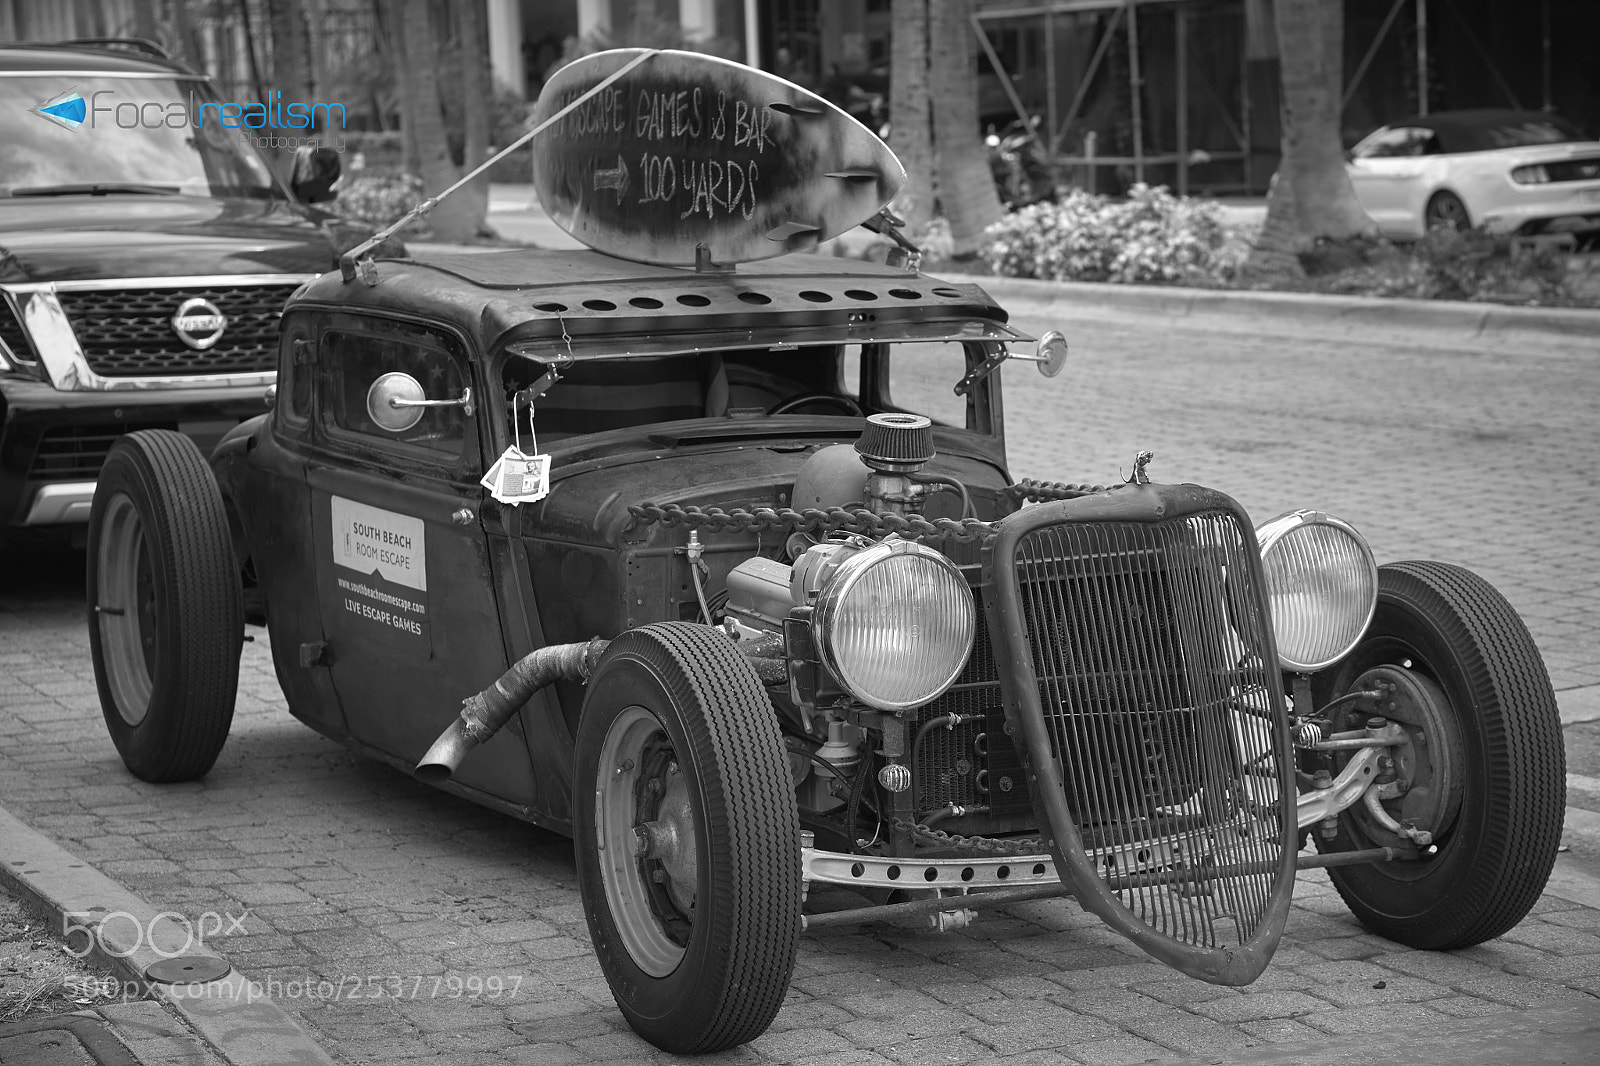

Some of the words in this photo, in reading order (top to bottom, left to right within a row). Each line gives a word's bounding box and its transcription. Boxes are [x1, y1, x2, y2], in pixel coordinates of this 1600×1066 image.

[637, 87, 703, 141] GAMES
[734, 100, 776, 153] BAR
[639, 152, 676, 204] 100
[680, 159, 759, 221] YARDS
[353, 522, 381, 541] SOUTH
[383, 531, 412, 550] BEACH
[356, 542, 378, 560] ROOM
[380, 549, 410, 570] ESCAPE
[337, 577, 426, 614] www.southbeachroomescape.com
[344, 597, 362, 615] LIVE
[362, 605, 391, 625] ESCAPE
[392, 615, 422, 636] GAMES
